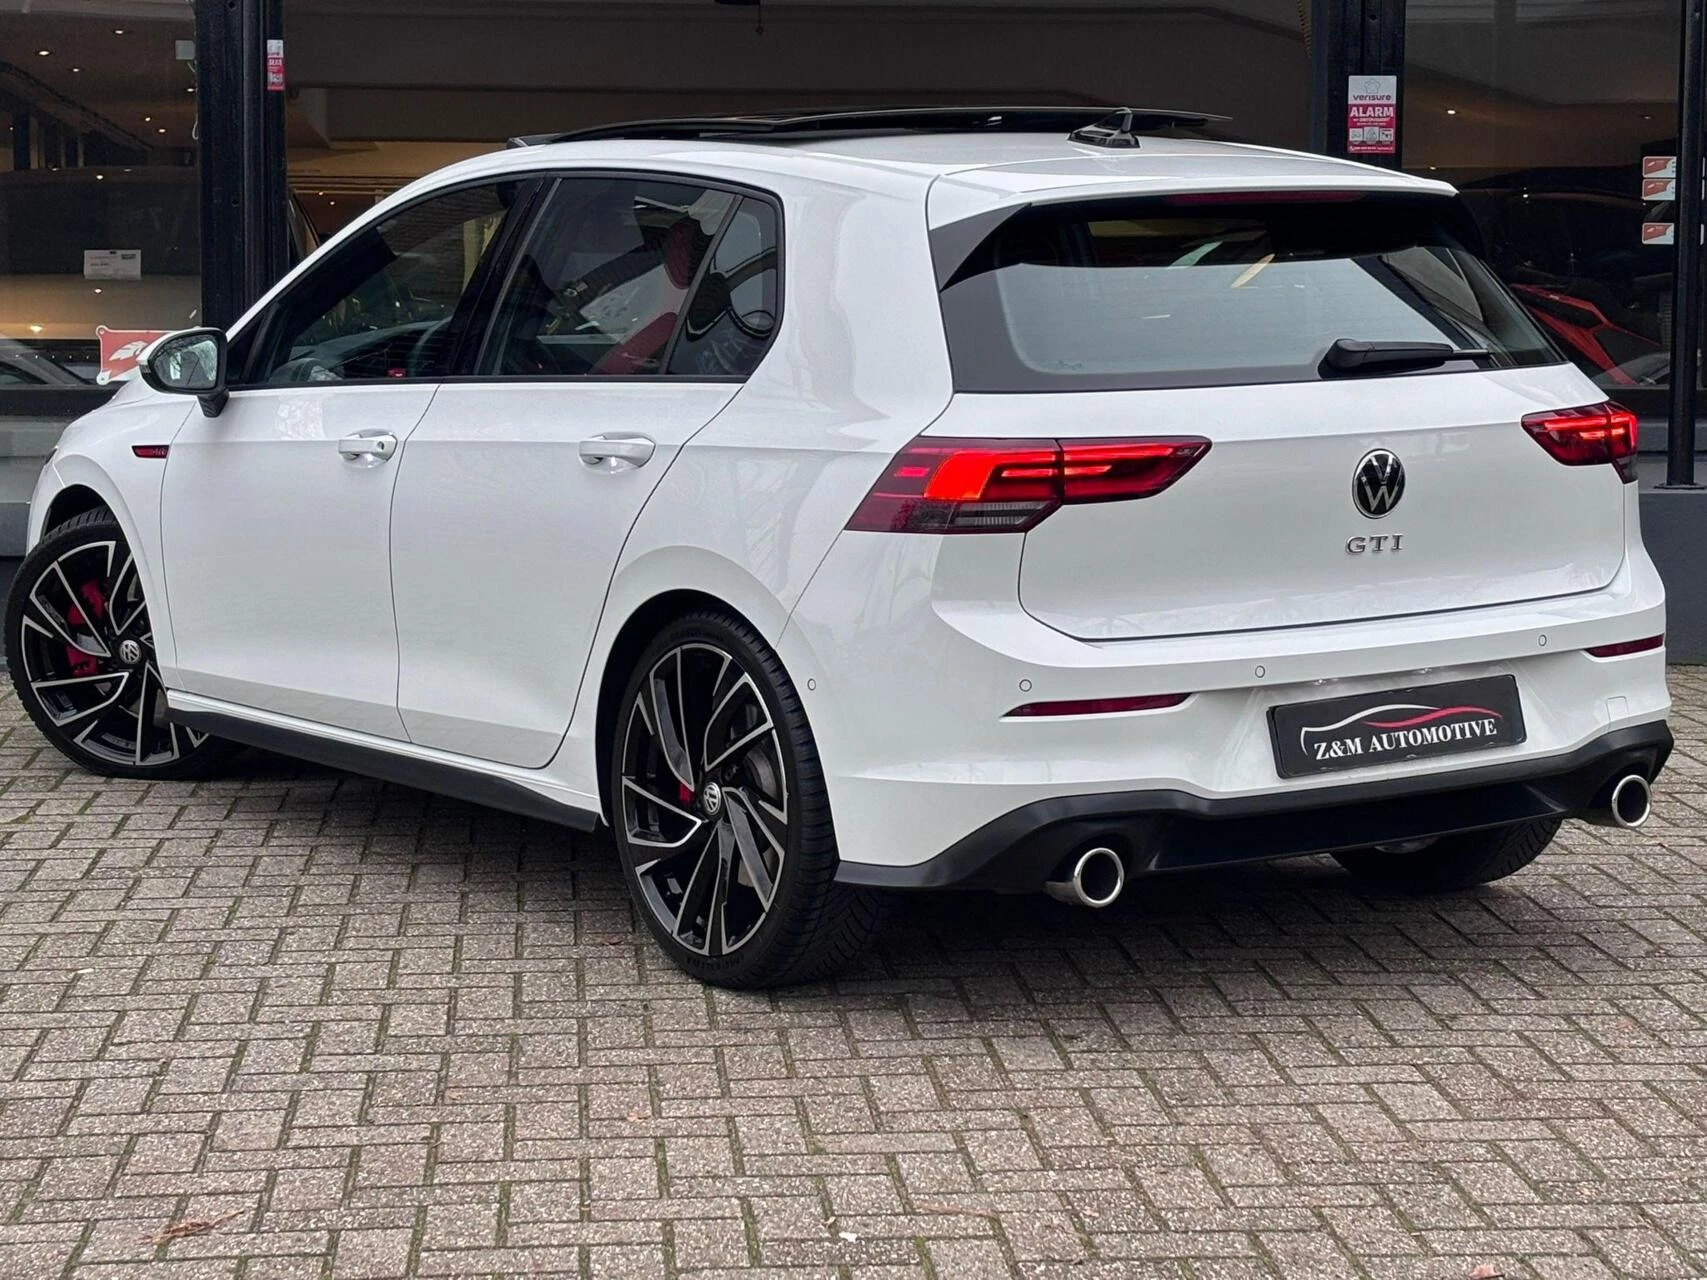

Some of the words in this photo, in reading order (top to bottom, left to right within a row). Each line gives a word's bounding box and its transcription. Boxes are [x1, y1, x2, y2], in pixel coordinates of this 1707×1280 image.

[1350, 106, 1394, 117] ALARM
[1354, 451, 1404, 514] VW
[1346, 533, 1403, 554] GTI
[1313, 736, 1363, 760] Z&M
[1368, 718, 1498, 753] AUTOMOTIVE
